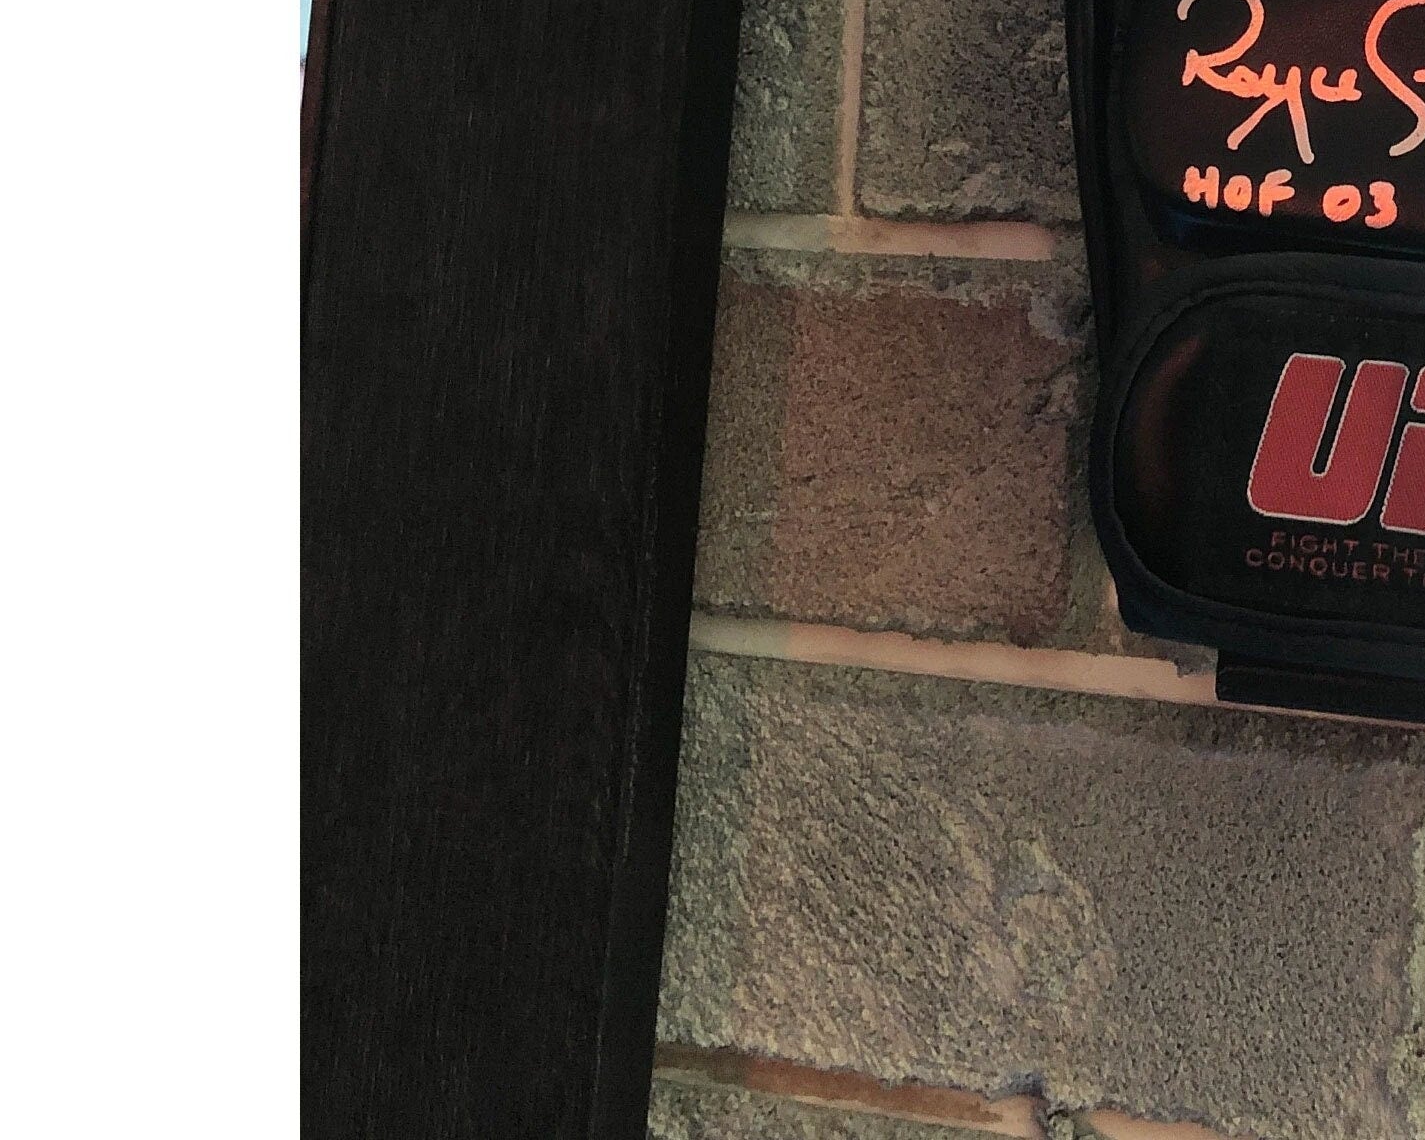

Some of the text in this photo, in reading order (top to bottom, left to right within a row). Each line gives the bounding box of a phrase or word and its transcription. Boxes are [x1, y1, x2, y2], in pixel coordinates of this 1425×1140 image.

[1183, 165, 1398, 229] HOF 03
[1271, 531, 1360, 556] FIGHT
[1245, 547, 1390, 582] CONQUER
